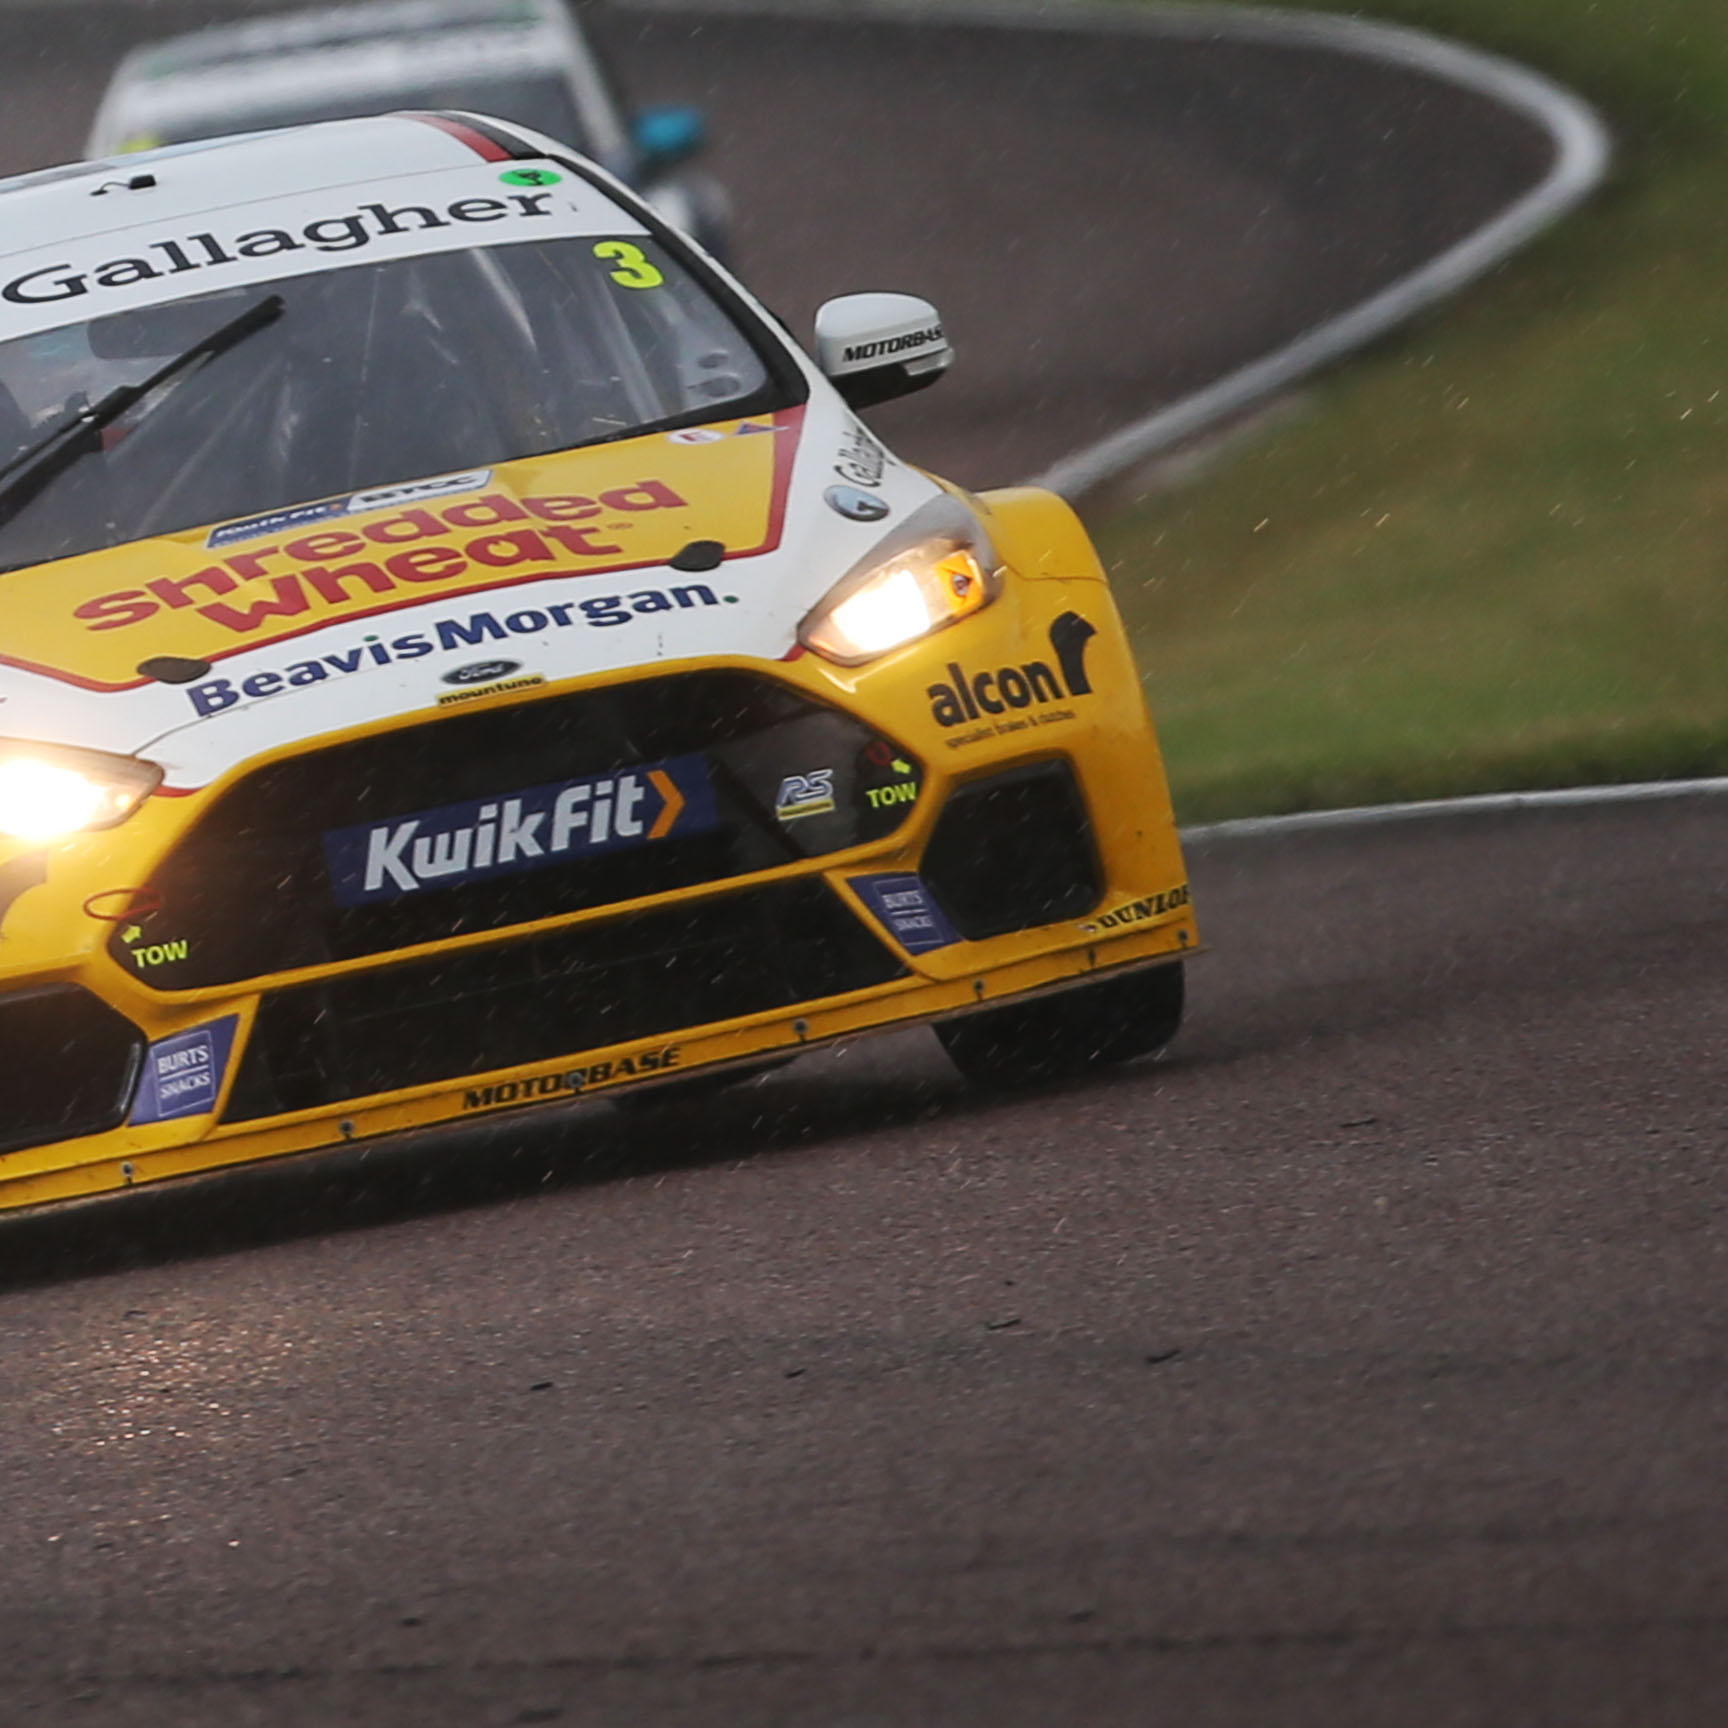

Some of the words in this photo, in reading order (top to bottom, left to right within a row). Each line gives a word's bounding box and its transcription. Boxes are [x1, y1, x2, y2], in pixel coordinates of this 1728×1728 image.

[0, 191, 553, 305] Gallagher
[593, 240, 664, 289] 3
[842, 323, 943, 362] MOTORBAS
[439, 677, 543, 704] mountune
[927, 661, 1065, 728] alcon
[865, 782, 917, 808] TOW
[132, 939, 189, 969] TOW
[157, 1045, 210, 1074] BURTS
[160, 1072, 211, 1099] SNACKS
[461, 1046, 682, 1111] MOTOBASE
